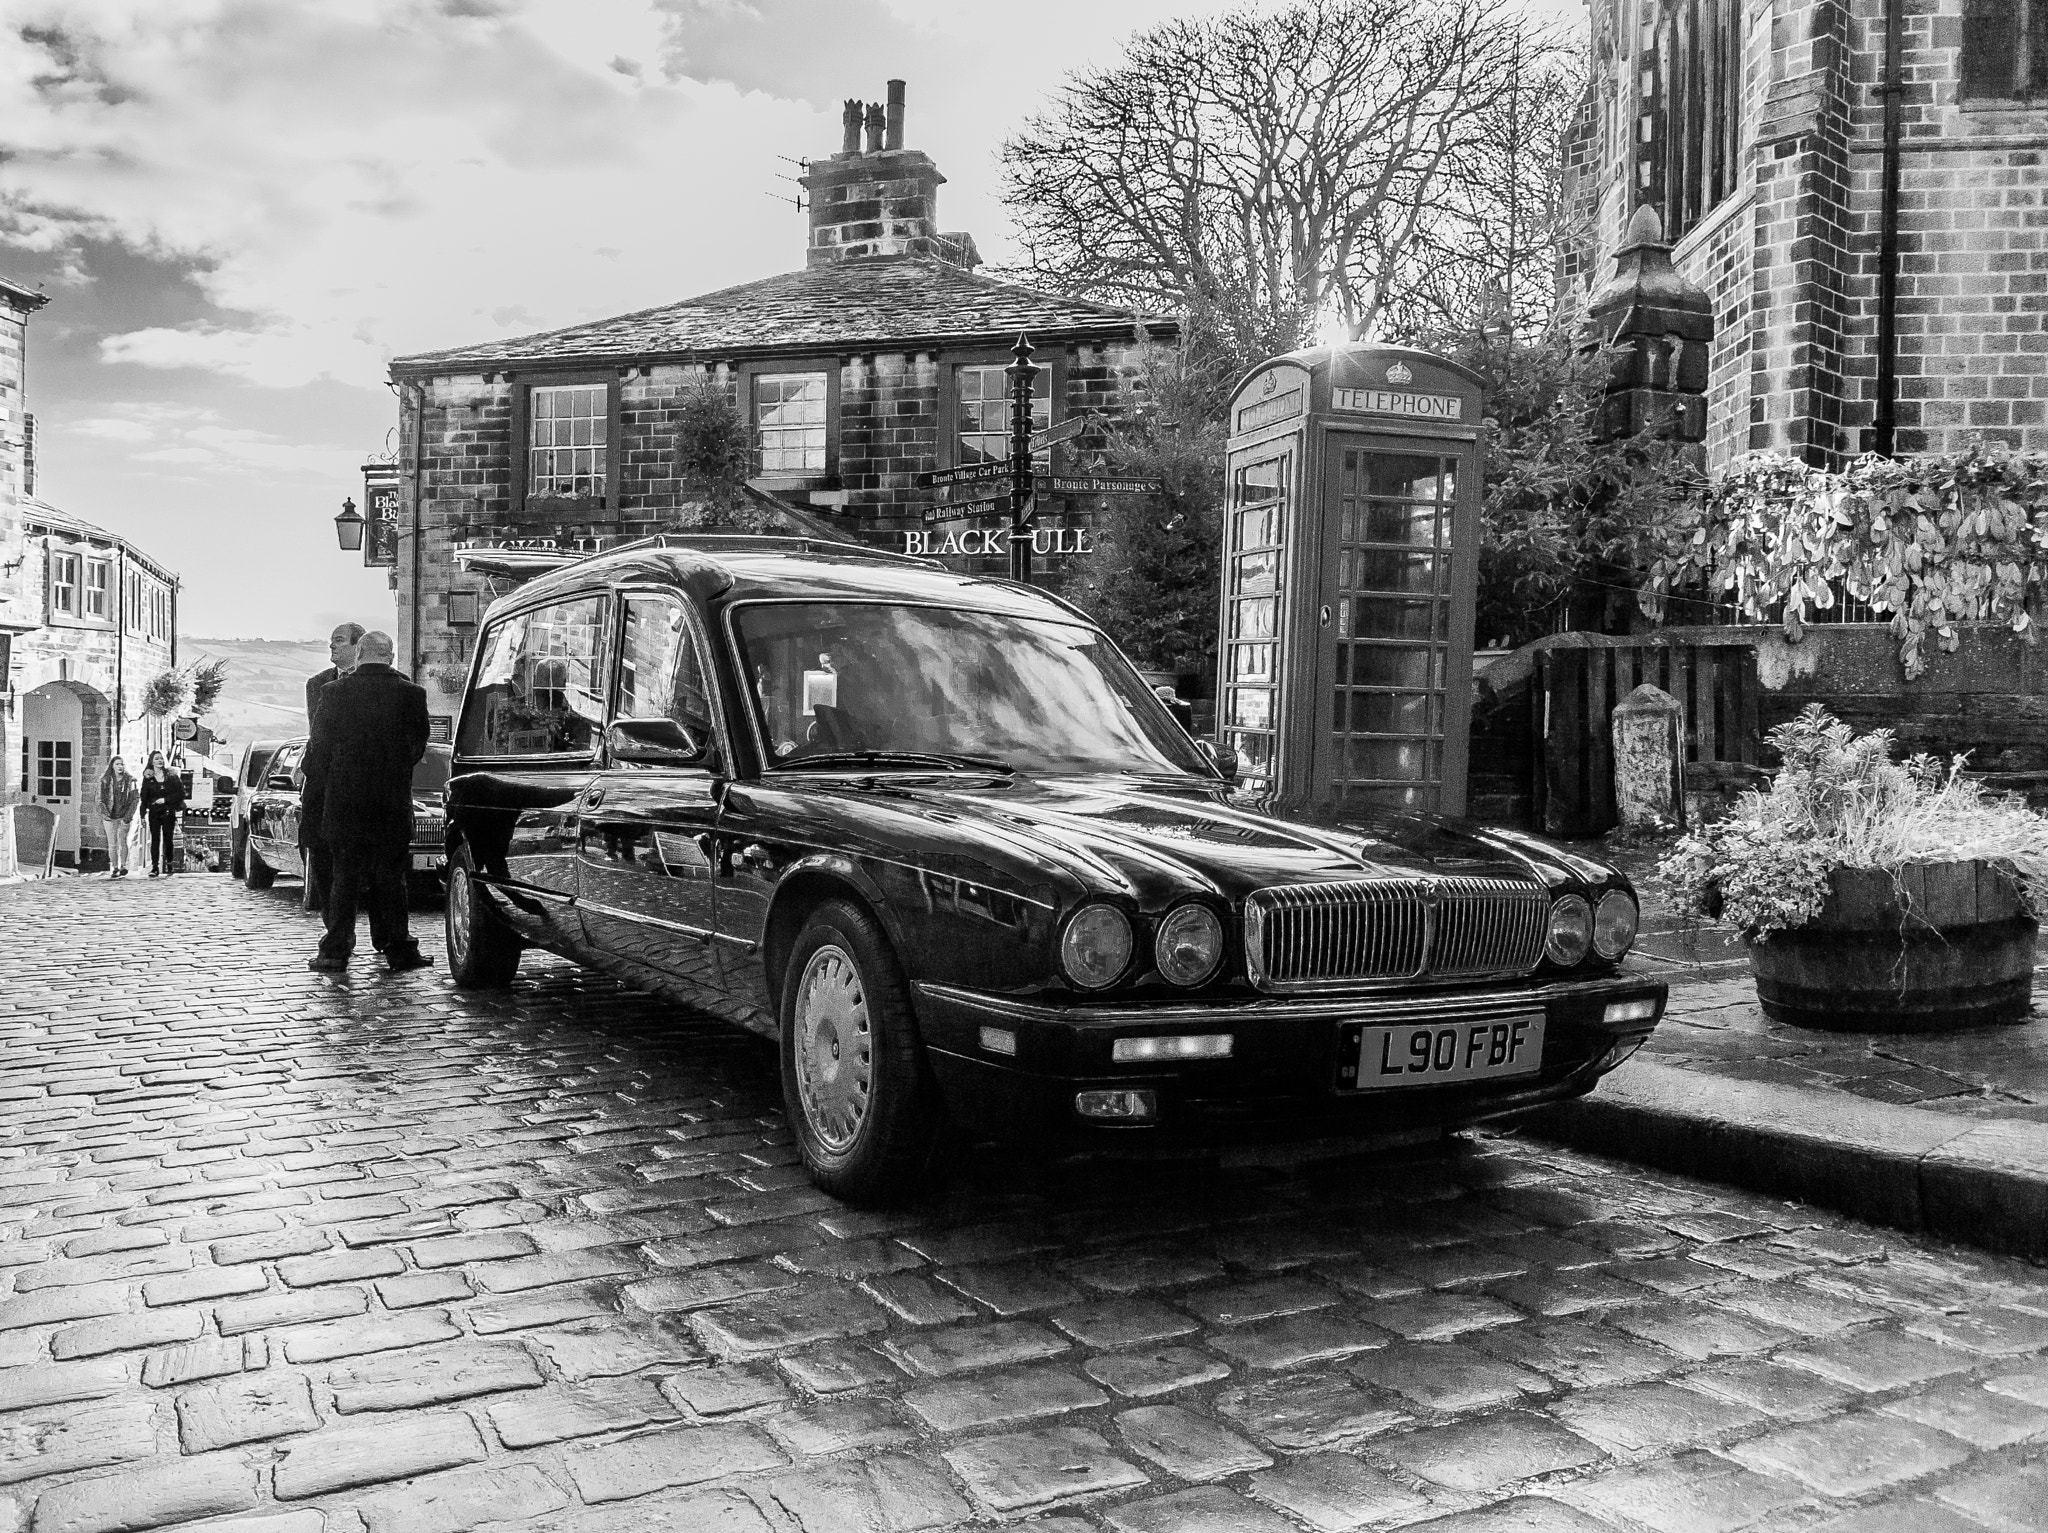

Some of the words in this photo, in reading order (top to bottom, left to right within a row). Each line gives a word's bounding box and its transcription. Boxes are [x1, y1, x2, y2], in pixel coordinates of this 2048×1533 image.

[1337, 389, 1457, 416] TELEPHONE
[955, 469, 976, 481] Village
[978, 466, 991, 477] Car
[992, 463, 1009, 475] Park
[1092, 478, 1146, 492] Parsonage
[936, 506, 965, 518] Railway
[967, 501, 995, 514] Station
[904, 530, 1006, 555] BLACK
[1032, 529, 1093, 554] ULL
[1381, 1030, 1457, 1075] L90
[1465, 1021, 1531, 1068] FBF
